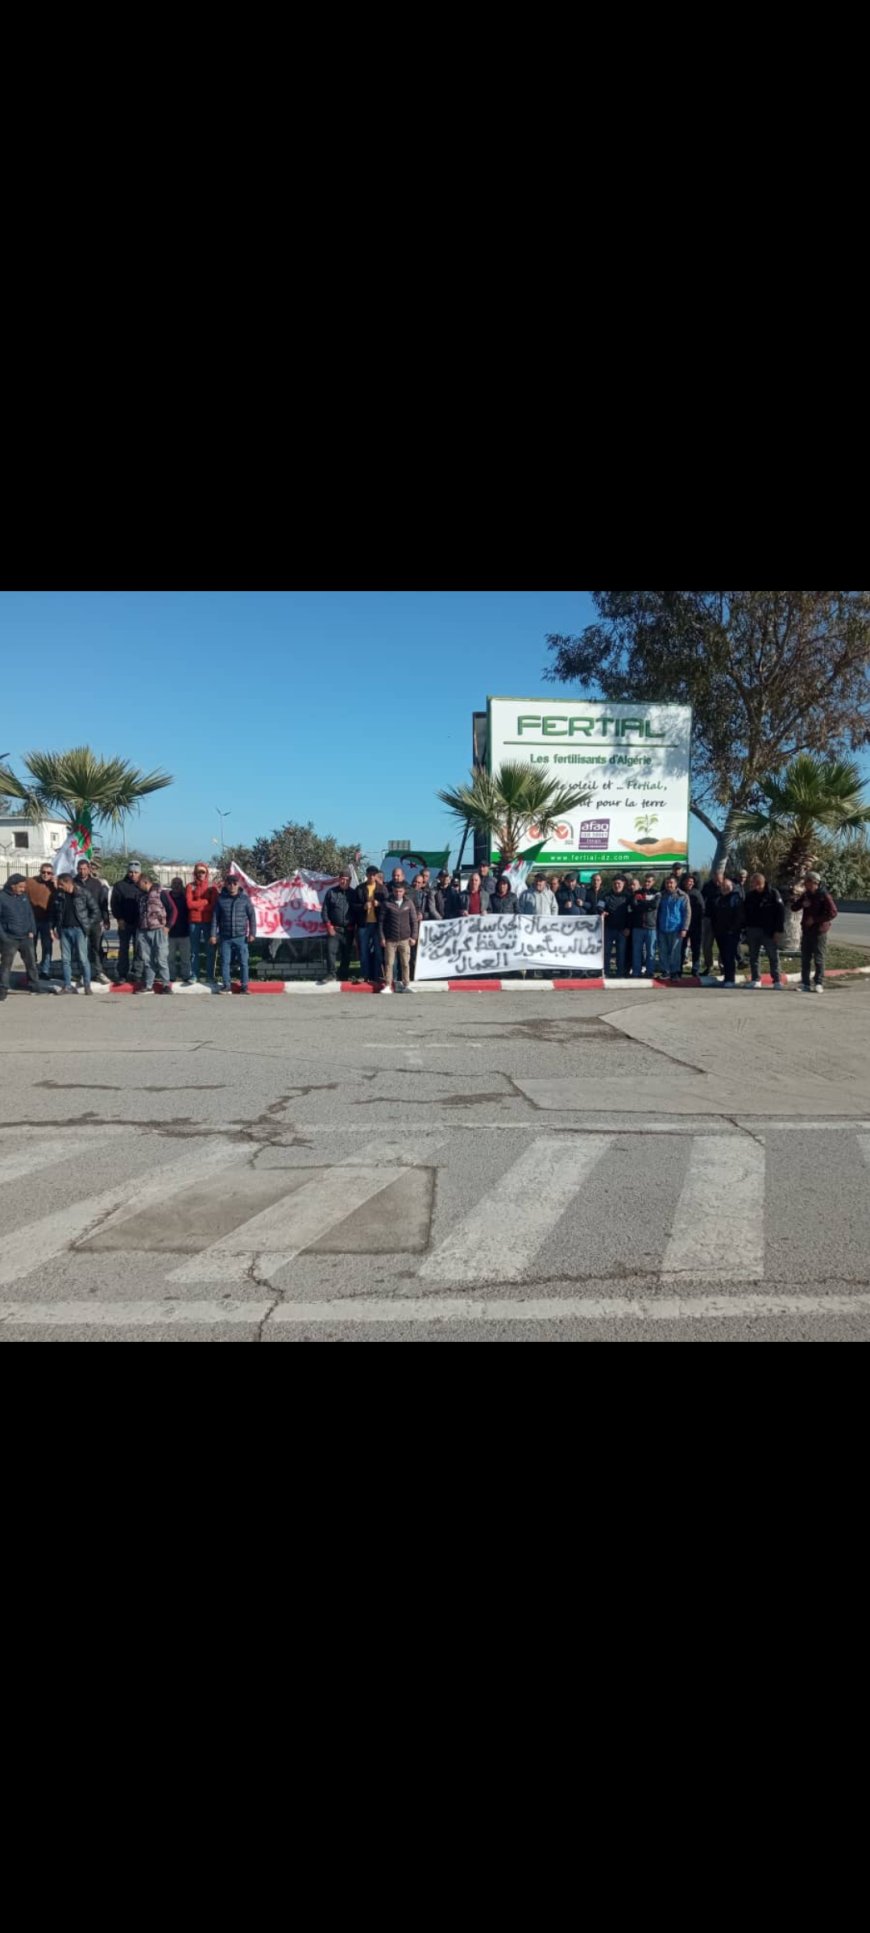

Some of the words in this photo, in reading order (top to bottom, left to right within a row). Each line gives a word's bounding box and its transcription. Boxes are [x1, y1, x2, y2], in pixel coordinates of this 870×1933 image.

[517, 715, 666, 738] FERTIAL
[530, 754, 550, 764] Les
[553, 754, 607, 765] fertilisants
[609, 755, 652, 767] d'Algérie
[568, 779, 598, 790] soleil
[602, 780, 613, 790] et
[627, 780, 668, 791] Fertial,
[596, 800, 621, 810] pour
[625, 798, 638, 807] la
[641, 799, 668, 808] terre
[550, 854, 630, 862] www.fertial-dz.com
[524, 916, 560, 935] عمال
[455, 952, 508, 974] العمال
